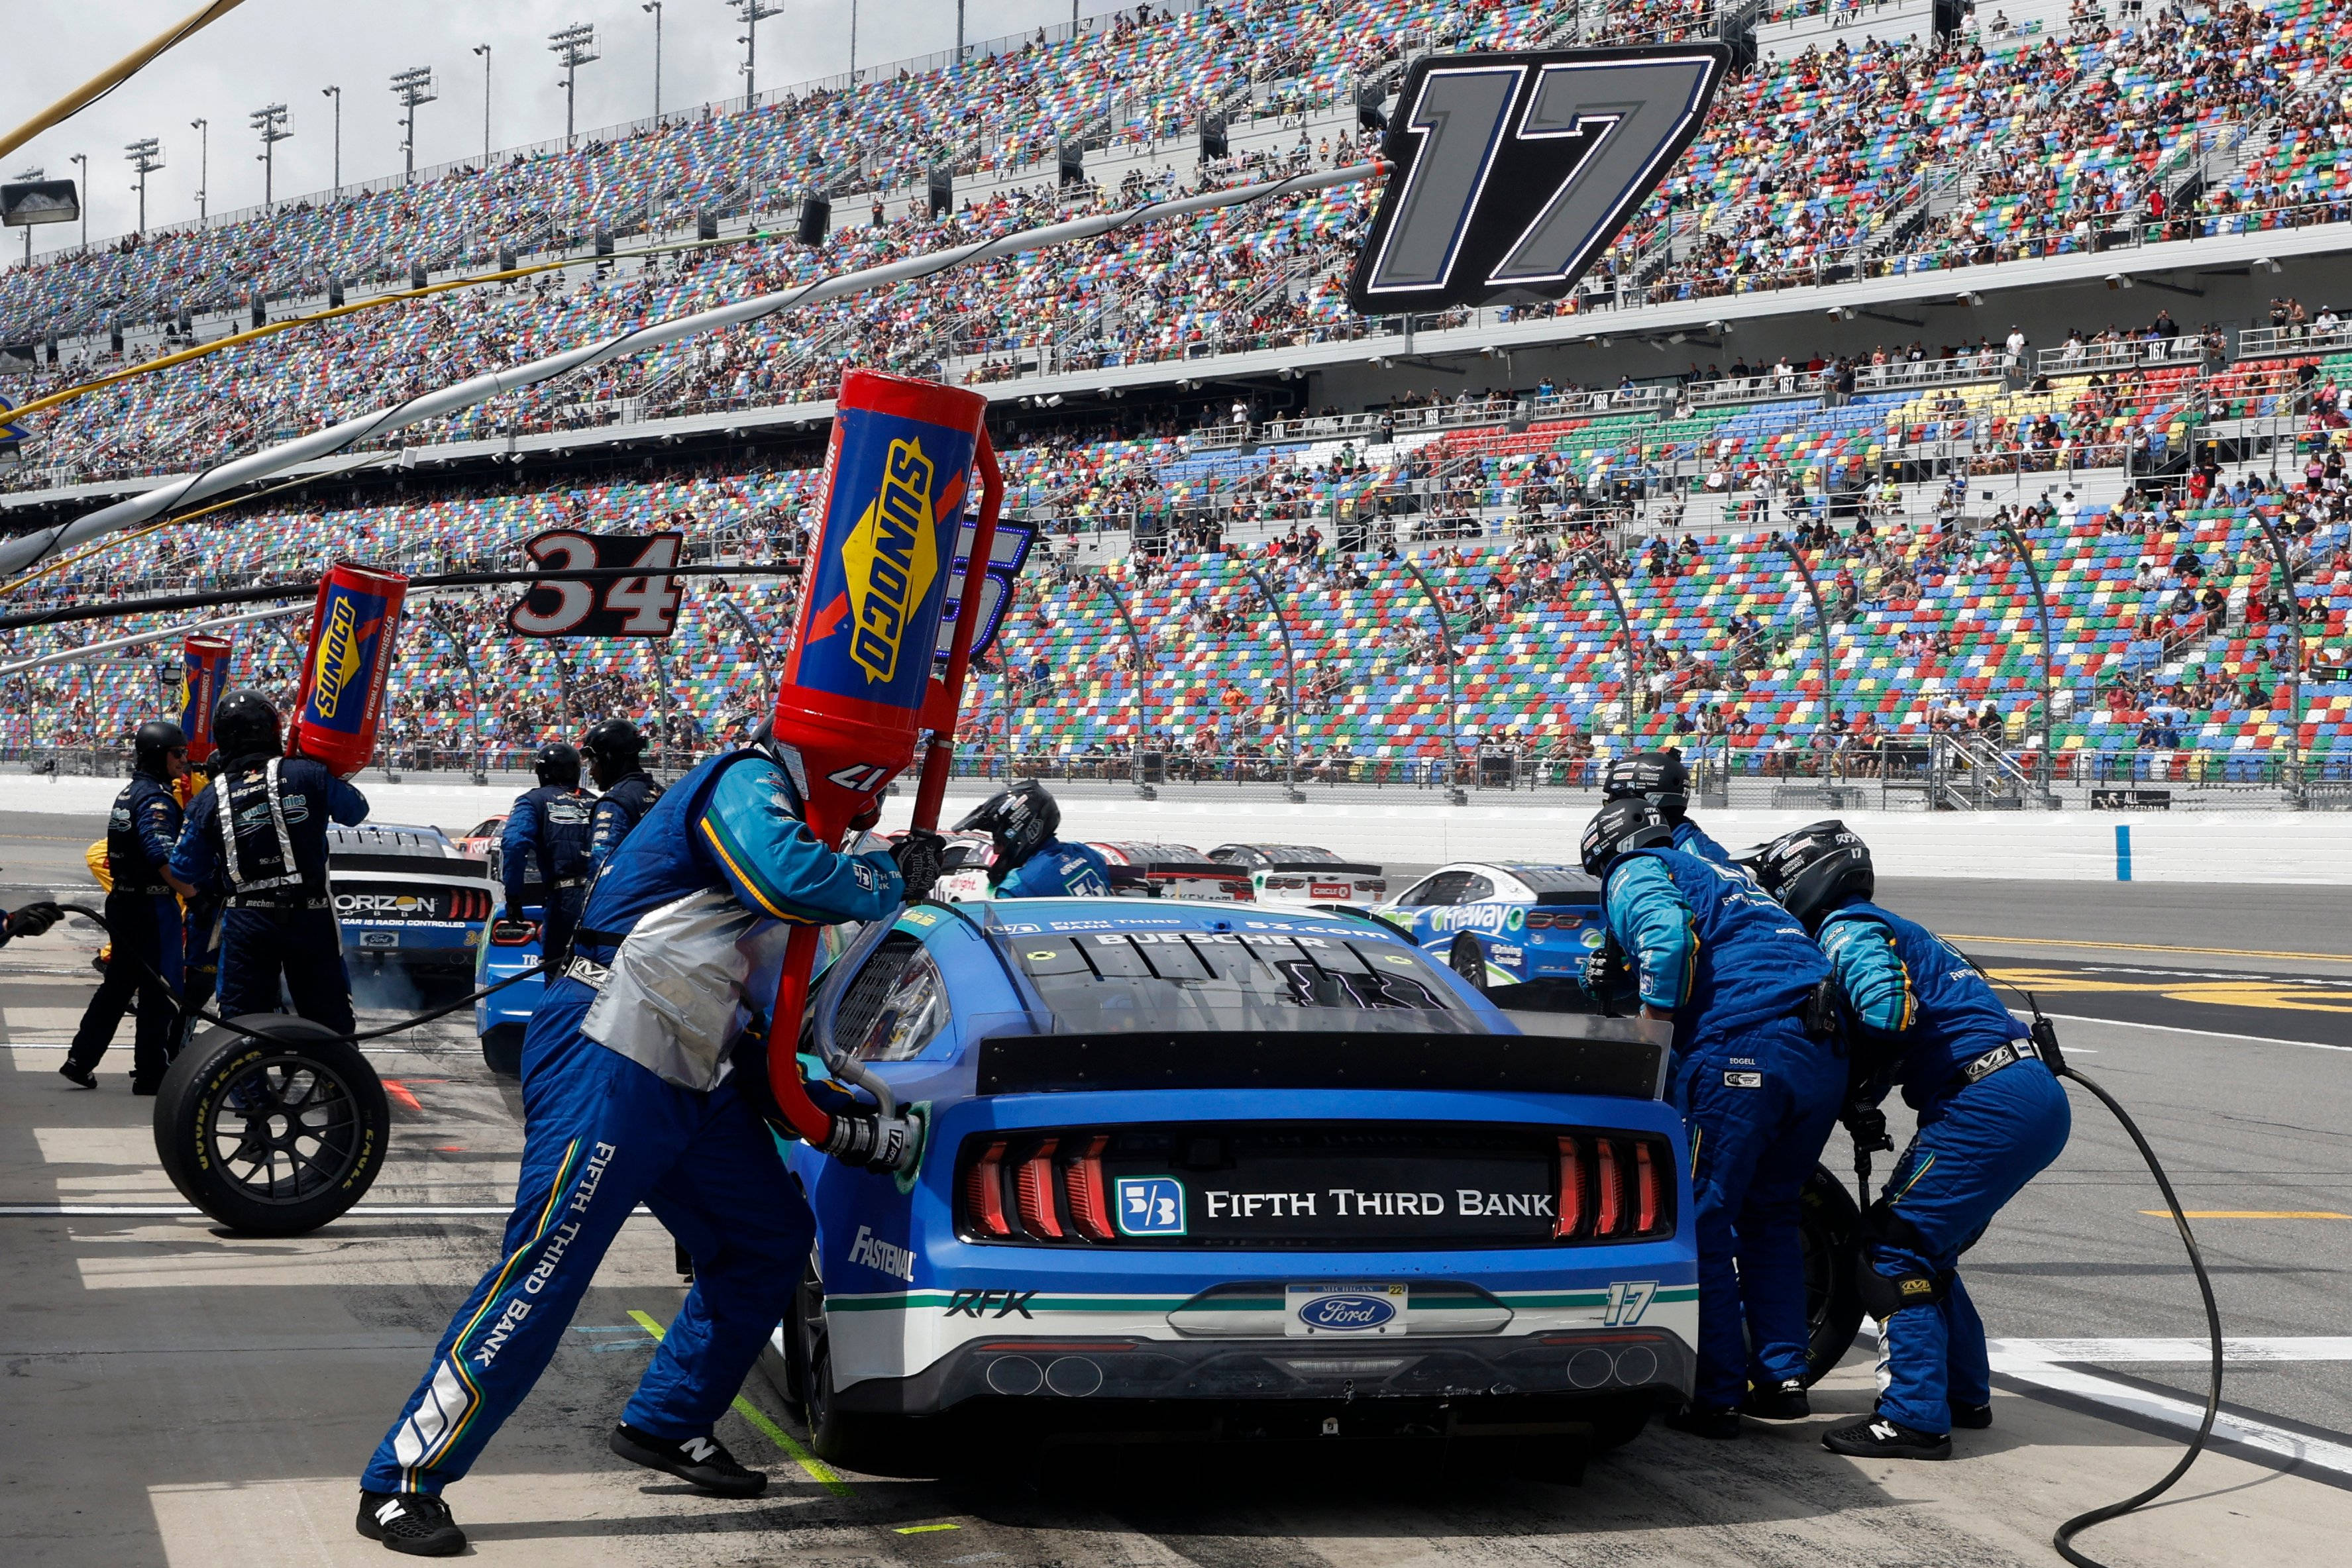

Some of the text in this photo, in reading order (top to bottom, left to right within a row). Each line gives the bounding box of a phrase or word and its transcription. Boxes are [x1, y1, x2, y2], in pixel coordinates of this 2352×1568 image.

[1367, 56, 1716, 294] 17
[2148, 341, 2166, 360] 167
[1779, 376, 1795, 393] 167
[1593, 393, 1608, 410] 168
[1424, 409, 1439, 425] 169
[1271, 424, 1284, 439] 170
[855, 445, 928, 676] SUNOCO
[511, 533, 680, 635] 34
[318, 607, 354, 717] SUNOCO
[828, 764, 888, 792] 17
[2123, 792, 2139, 804] ALL
[1648, 814, 1661, 826] 17
[1850, 847, 1862, 859] 17
[334, 894, 435, 913] ORIZON
[406, 919, 465, 928] CONTROLLED
[1245, 921, 1389, 939] 53.com
[1094, 933, 1330, 948] BUESCHER
[890, 1130, 902, 1149] 17
[1204, 1190, 1317, 1218] FIFTH
[1328, 1188, 1444, 1216] THIRD
[1456, 1189, 1555, 1217] BANK
[474, 1141, 616, 1367] FIFTH THIRD BANK
[847, 1225, 917, 1283] FASTENAL
[1389, 1285, 1403, 1294] 22
[943, 1288, 1040, 1320] RFK
[1318, 1300, 1376, 1322] Ford
[1603, 1280, 1659, 1326] 17
